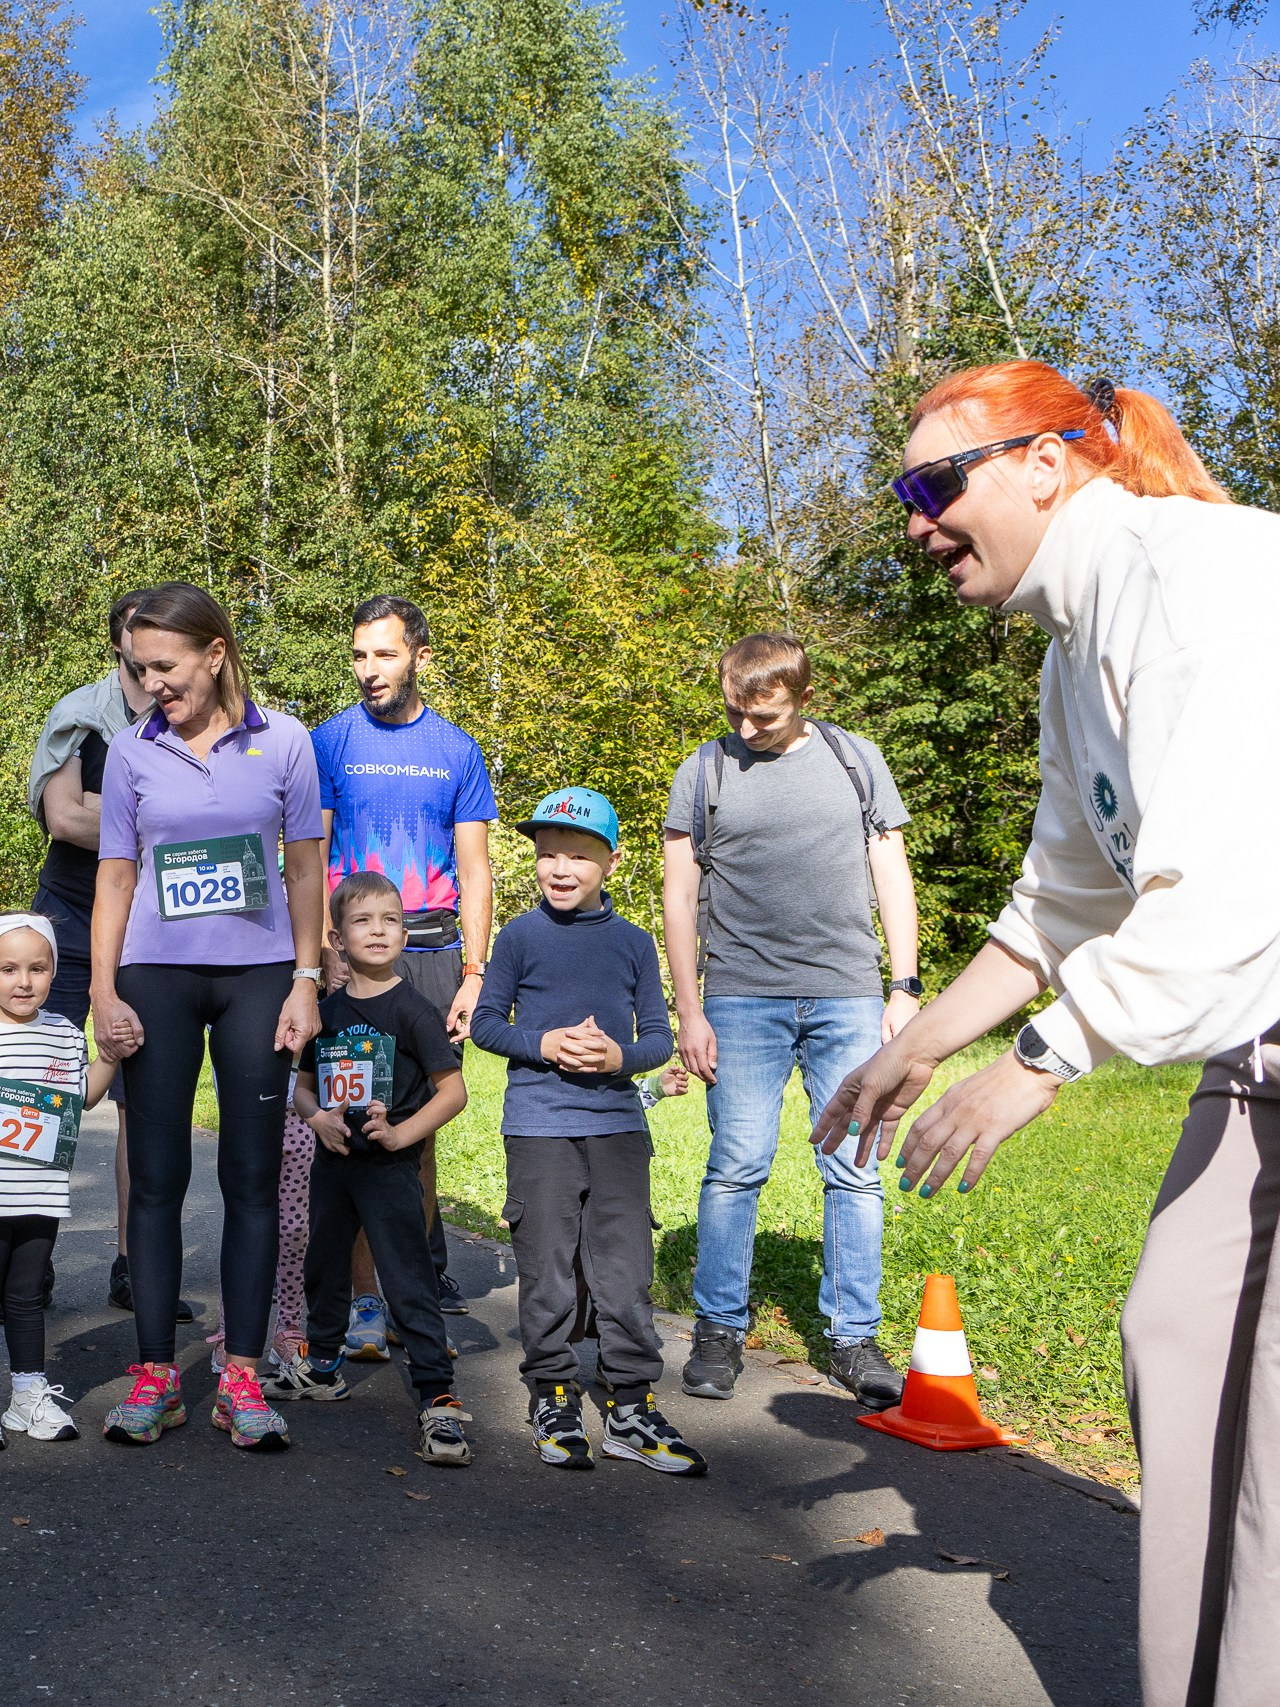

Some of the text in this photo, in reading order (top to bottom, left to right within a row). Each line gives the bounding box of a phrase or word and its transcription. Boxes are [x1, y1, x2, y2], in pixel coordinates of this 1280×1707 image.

[345, 764, 451, 781] СОВКОМБАНК
[164, 853, 208, 864] 5 городов
[166, 876, 242, 908] 1028
[347, 1024, 368, 1036] YOU
[320, 1048, 325, 1058] 5
[324, 1073, 364, 1103] 105
[1, 1091, 36, 1104] городов
[22, 1108, 38, 1117] Дети
[0, 1118, 43, 1152] 27
